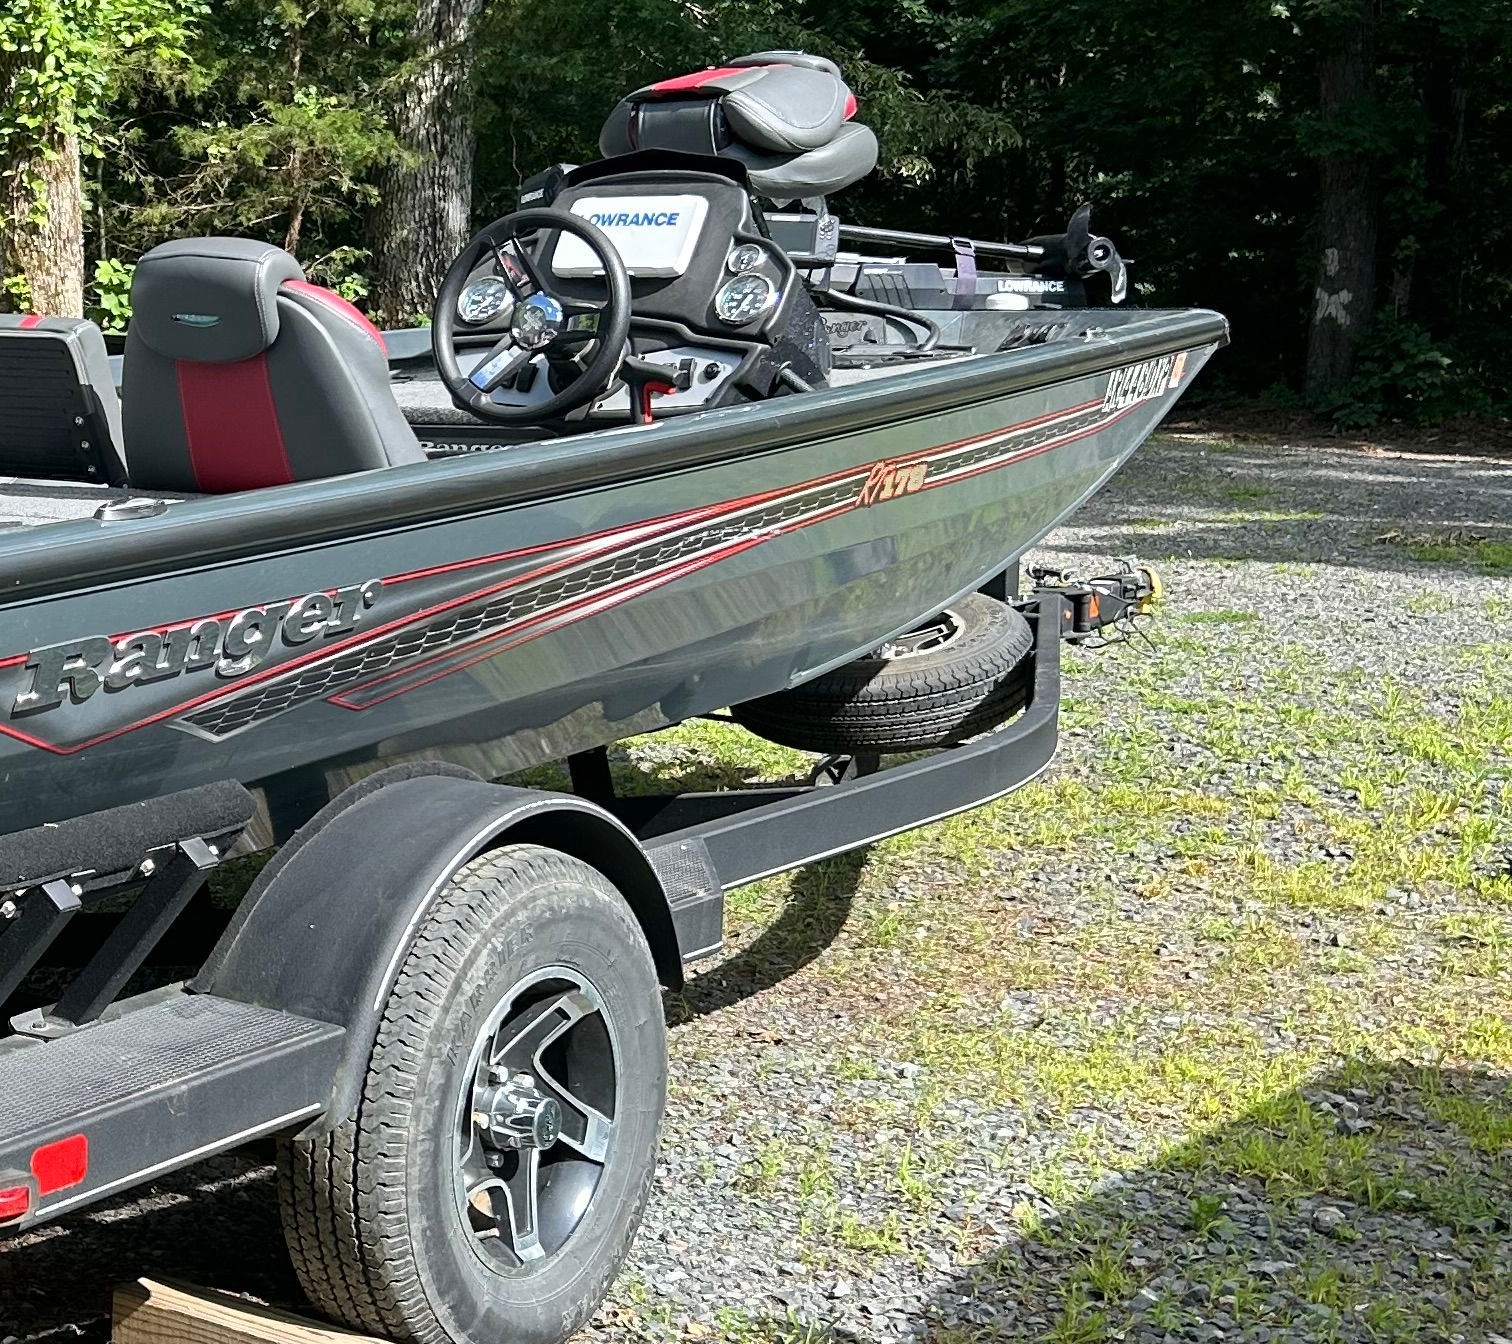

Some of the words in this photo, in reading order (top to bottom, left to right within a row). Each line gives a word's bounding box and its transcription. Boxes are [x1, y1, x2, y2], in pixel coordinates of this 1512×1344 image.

[580, 212, 679, 227] OWRANCE
[997, 279, 1065, 293] LOWRANCE
[10, 578, 384, 719] Ranger
